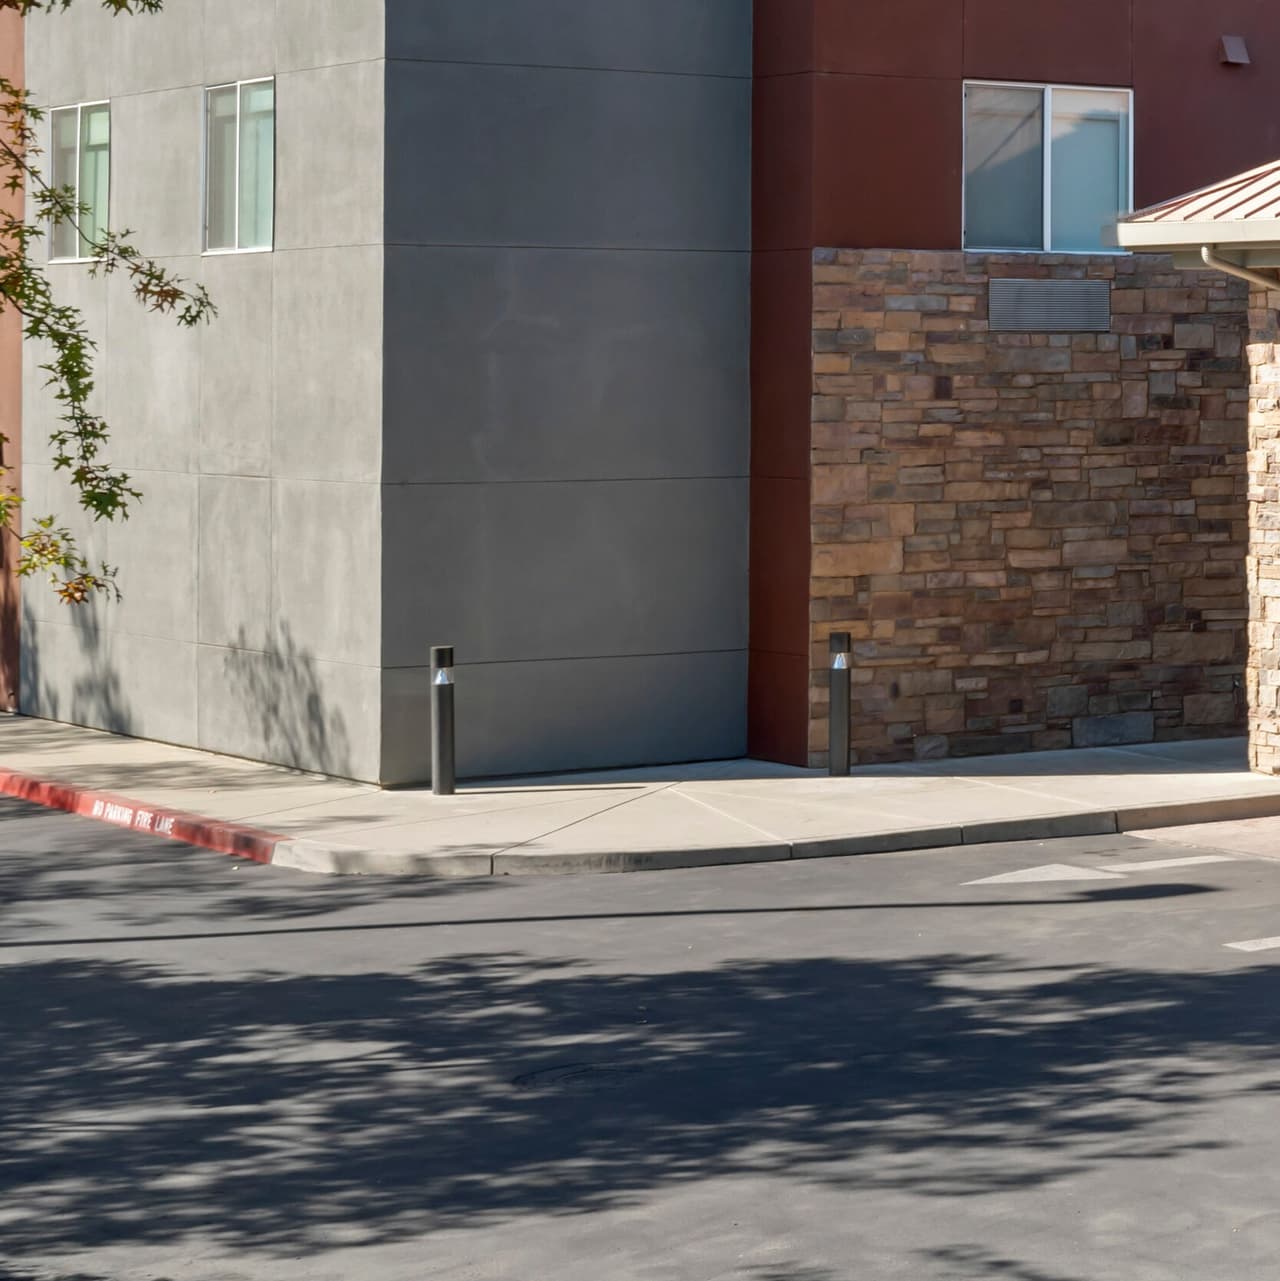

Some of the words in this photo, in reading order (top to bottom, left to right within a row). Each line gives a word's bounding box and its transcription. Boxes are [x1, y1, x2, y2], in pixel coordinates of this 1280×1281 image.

[104, 802, 133, 825] PARKING
[134, 810, 154, 830] FIRE
[154, 815, 176, 835] LANE
